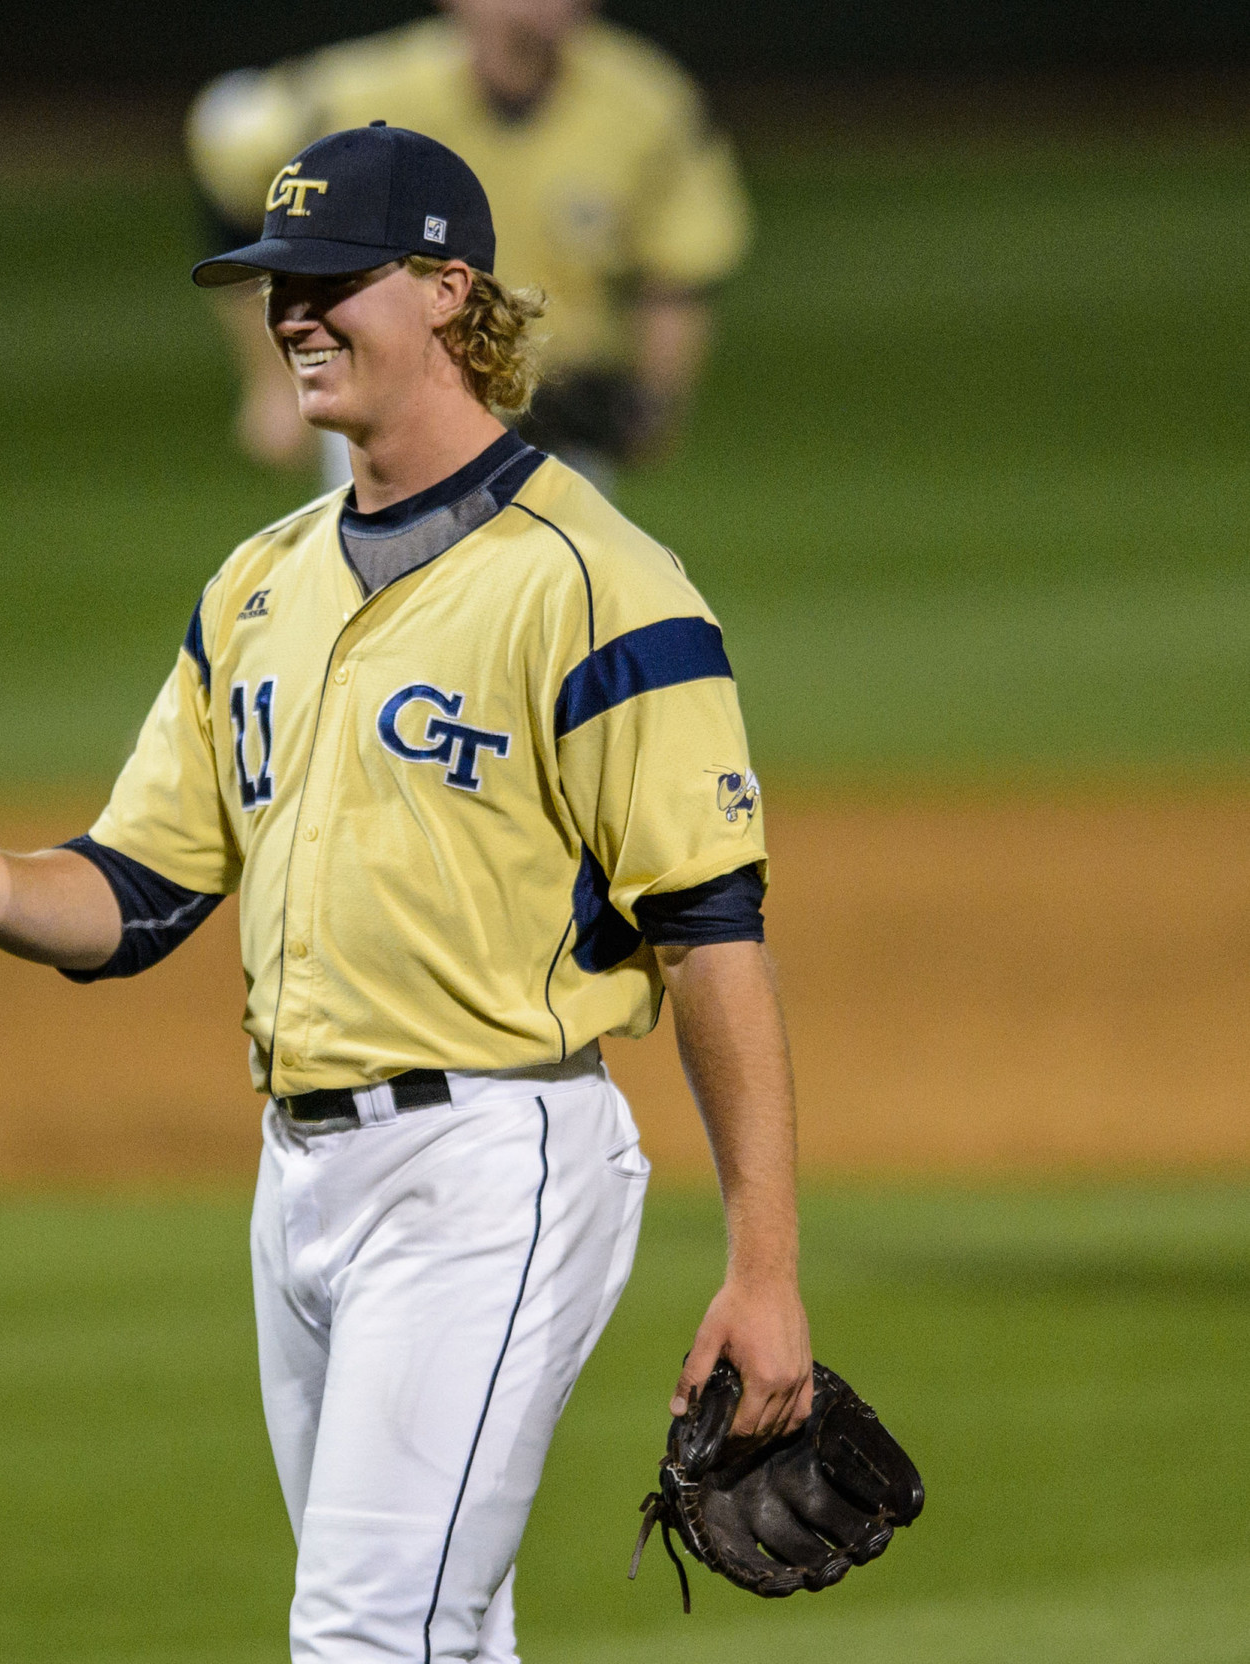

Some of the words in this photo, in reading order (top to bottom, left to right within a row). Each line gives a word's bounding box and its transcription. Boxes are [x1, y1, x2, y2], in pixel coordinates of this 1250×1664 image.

[265, 162, 329, 217] GT
[230, 674, 278, 812] 11
[376, 680, 512, 793] GT
